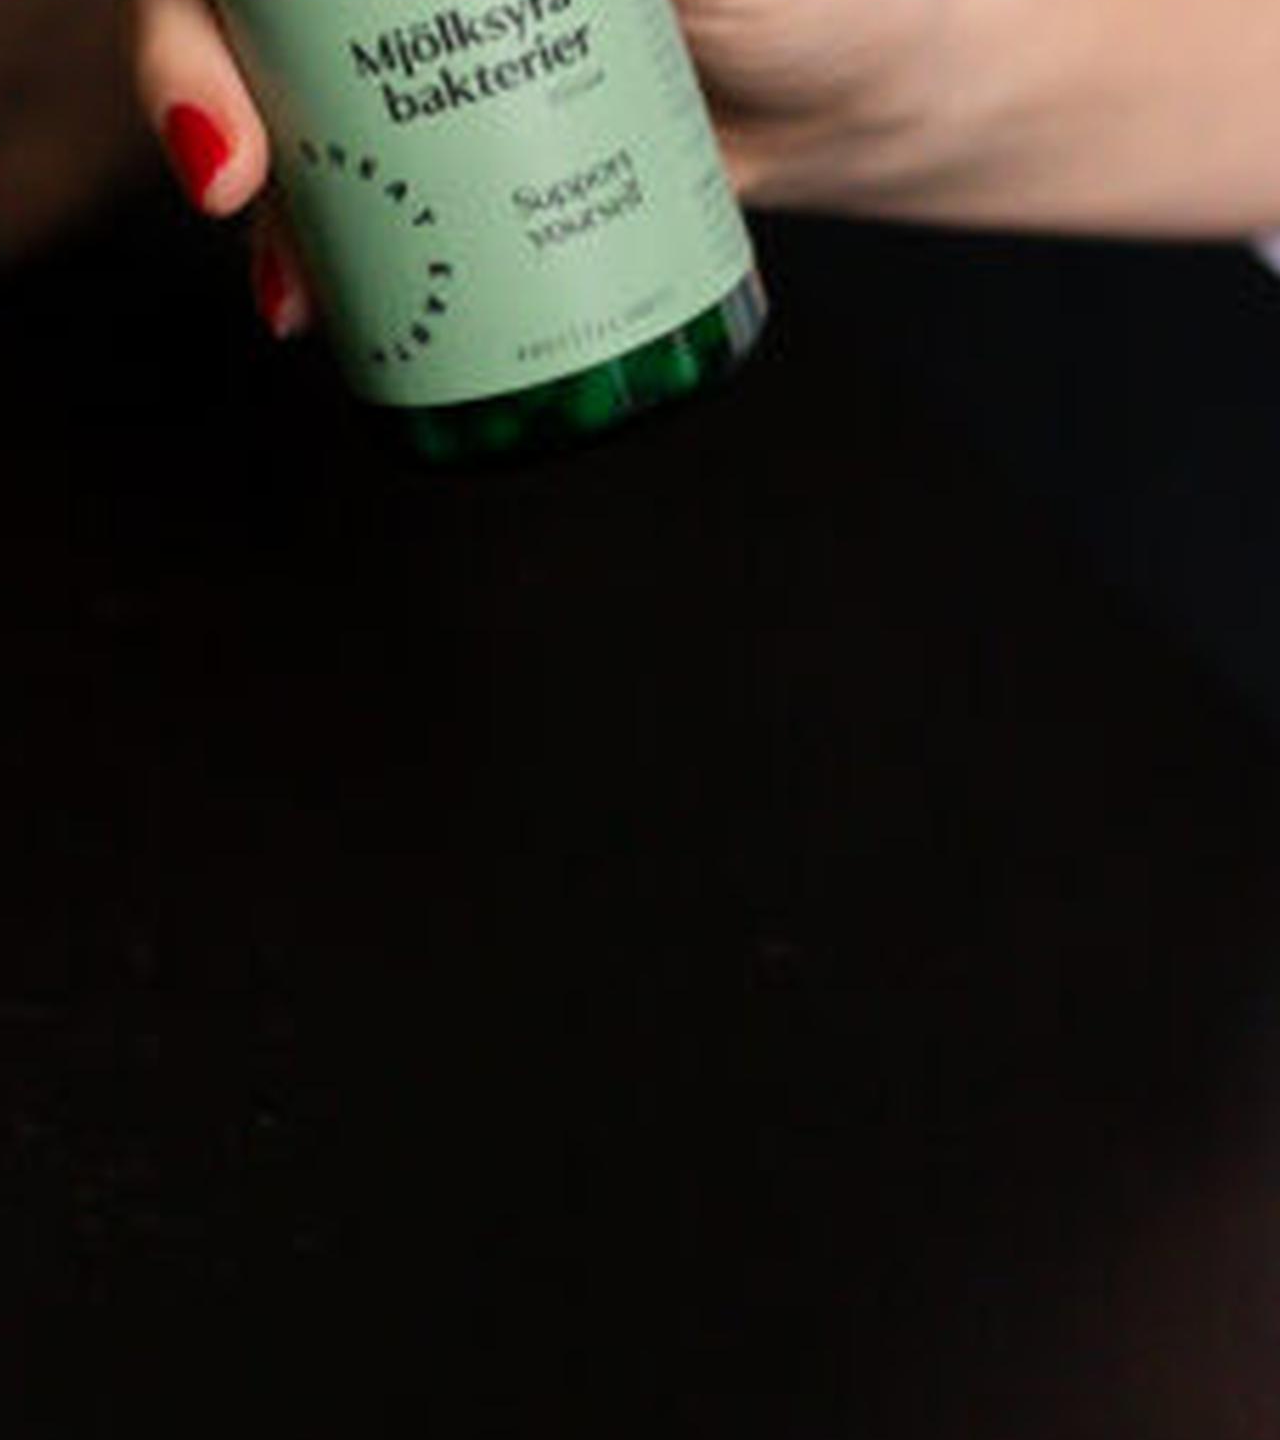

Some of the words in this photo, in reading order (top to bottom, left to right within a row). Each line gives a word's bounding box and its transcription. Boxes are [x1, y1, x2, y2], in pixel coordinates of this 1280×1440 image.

[382, 22, 591, 124] bakterier
[511, 149, 633, 216] Support
[525, 178, 644, 256] yourself
